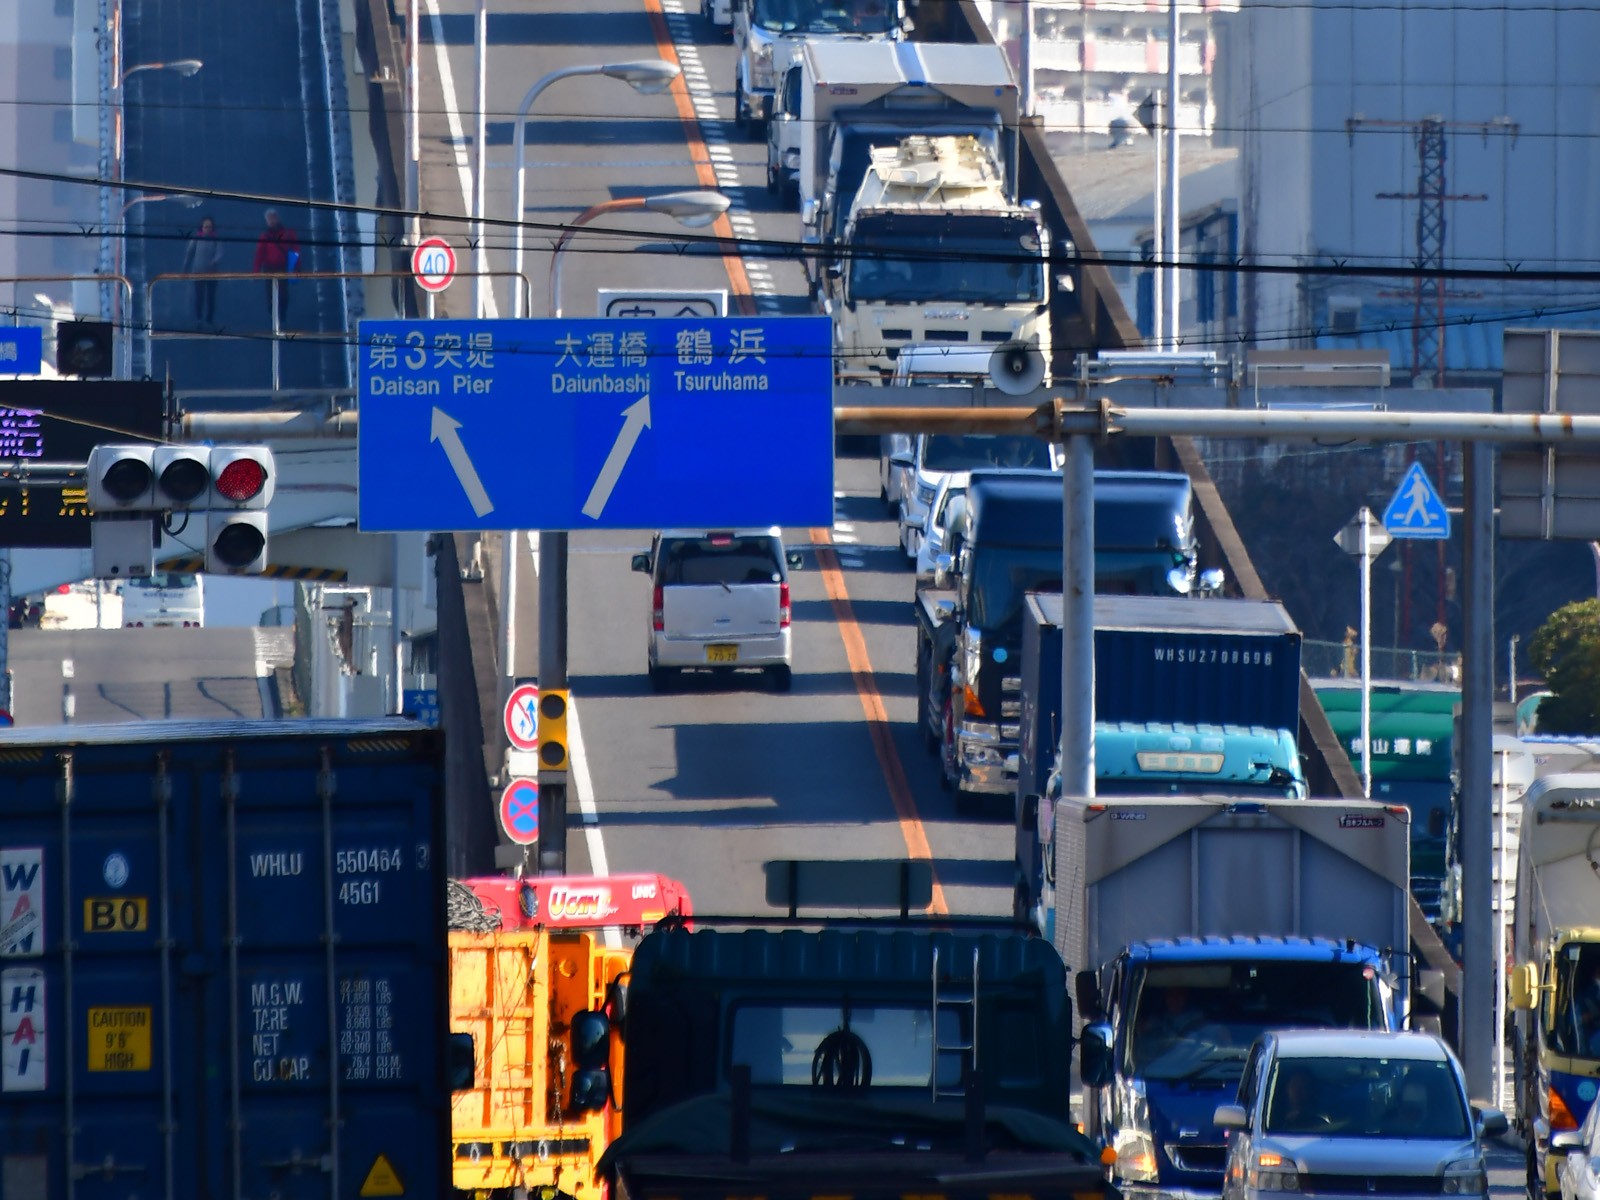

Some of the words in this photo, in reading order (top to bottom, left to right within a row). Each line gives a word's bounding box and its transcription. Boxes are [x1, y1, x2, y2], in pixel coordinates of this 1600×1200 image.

[423, 253, 446, 275] 40
[368, 330, 494, 370] 第3突堤
[554, 331, 648, 368] 大運橋
[370, 375, 440, 396] Daisan
[453, 374, 493, 395] Pier
[551, 372, 650, 394] Daiunbashi
[673, 370, 769, 392] Tsuruhama
[250, 852, 303, 878] WHLU
[336, 848, 402, 875] 550464
[417, 846, 430, 870] 3
[339, 880, 380, 905] 45G1
[631, 884, 656, 900] UNIC
[251, 982, 303, 1007] M.G.W.
[92, 1011, 145, 1028] CAUTION
[252, 1007, 288, 1031] TARE
[252, 1033, 280, 1057] NET
[104, 1052, 134, 1069] HIGH
